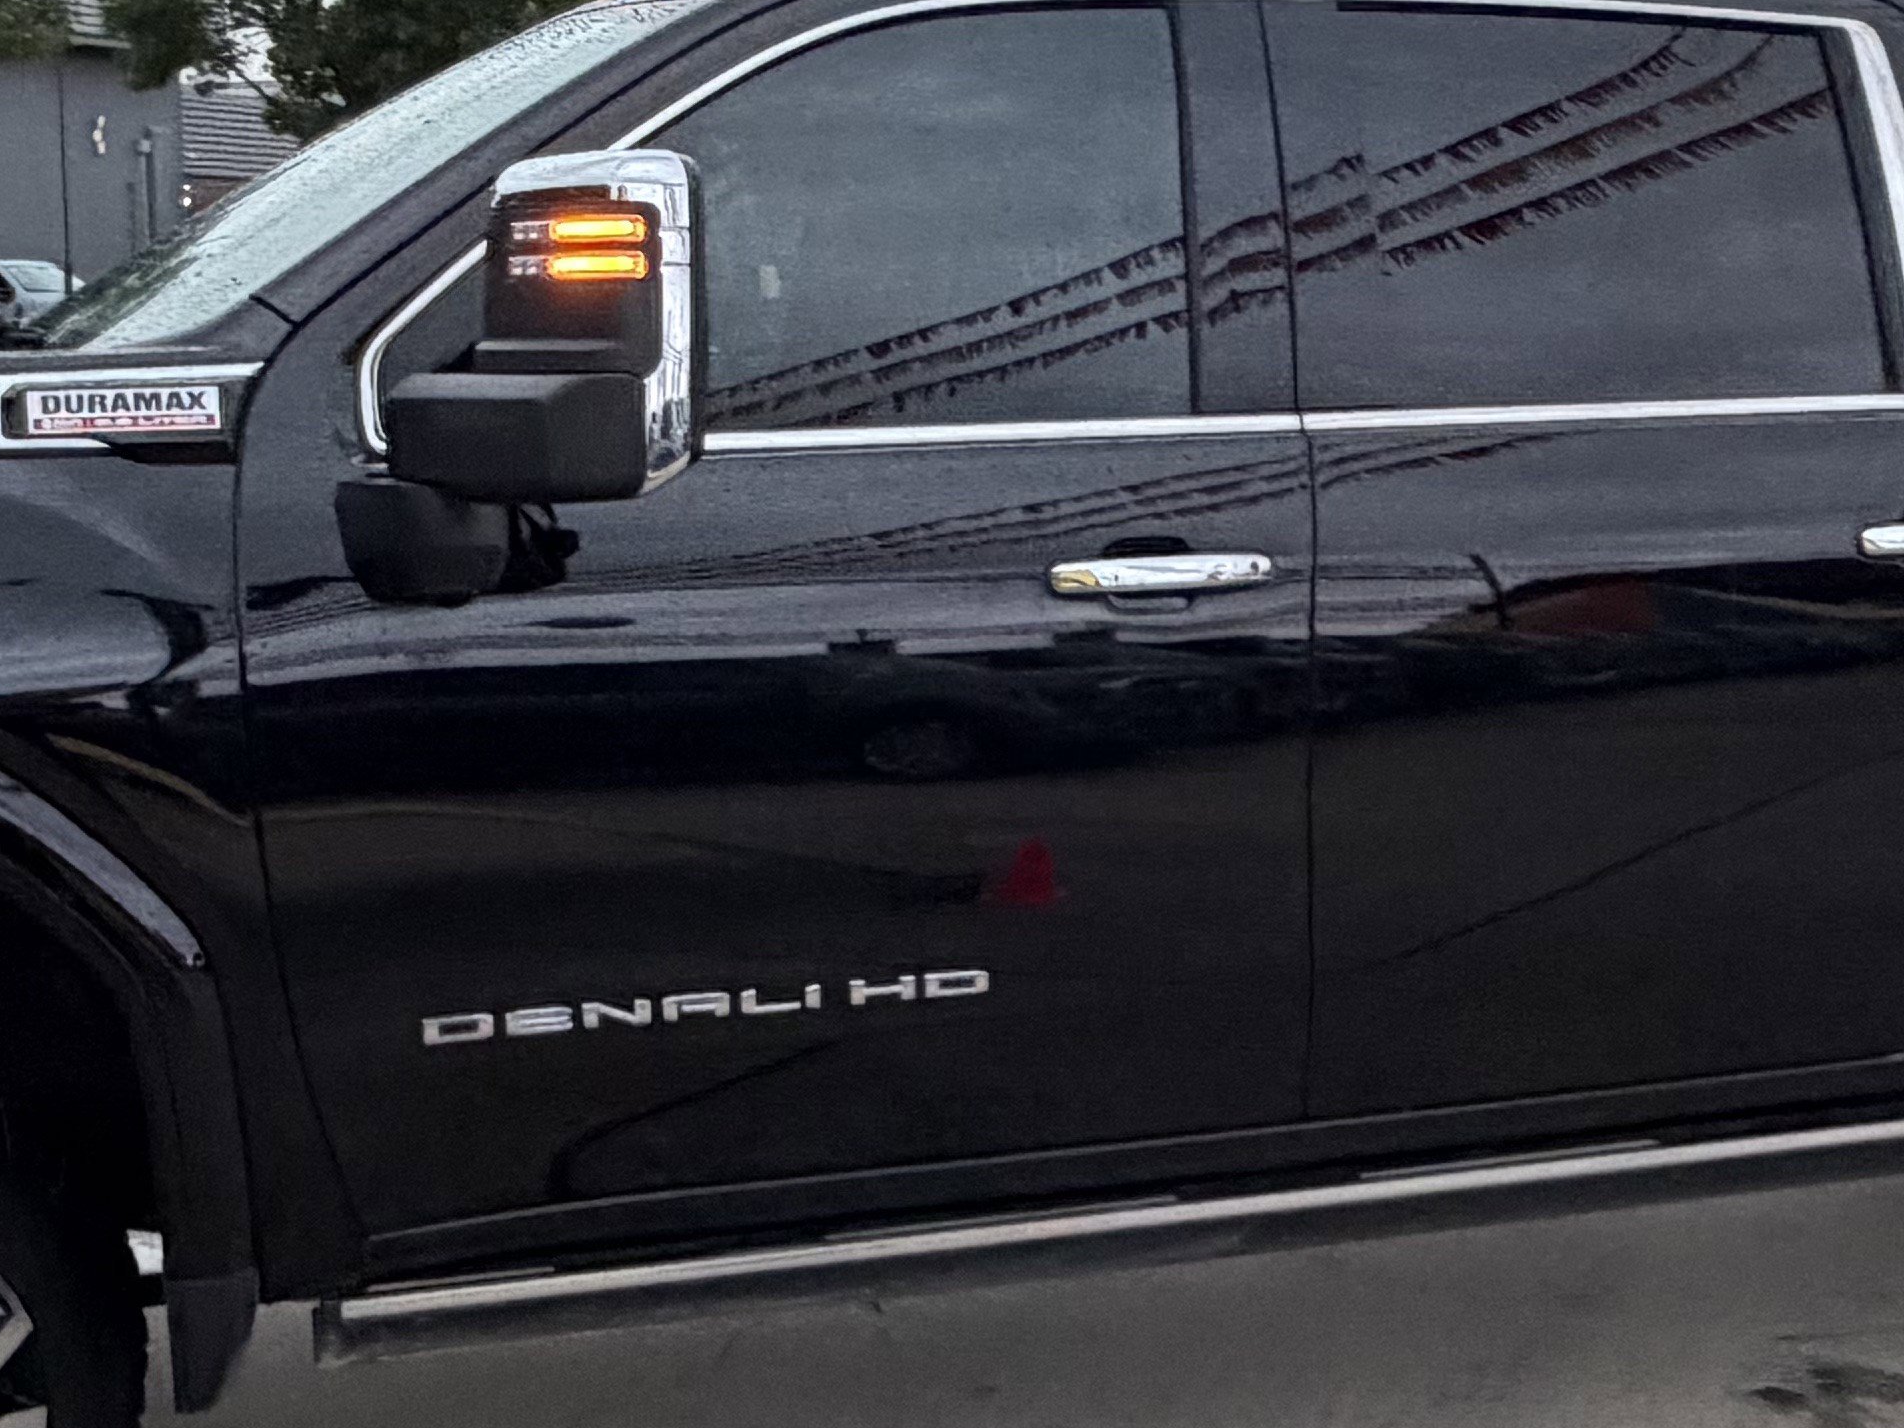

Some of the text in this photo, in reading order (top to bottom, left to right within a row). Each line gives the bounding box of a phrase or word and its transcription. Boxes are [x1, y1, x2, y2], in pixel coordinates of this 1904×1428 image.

[41, 390, 207, 414] DURAMAX
[421, 969, 990, 1046] DENALI HD
